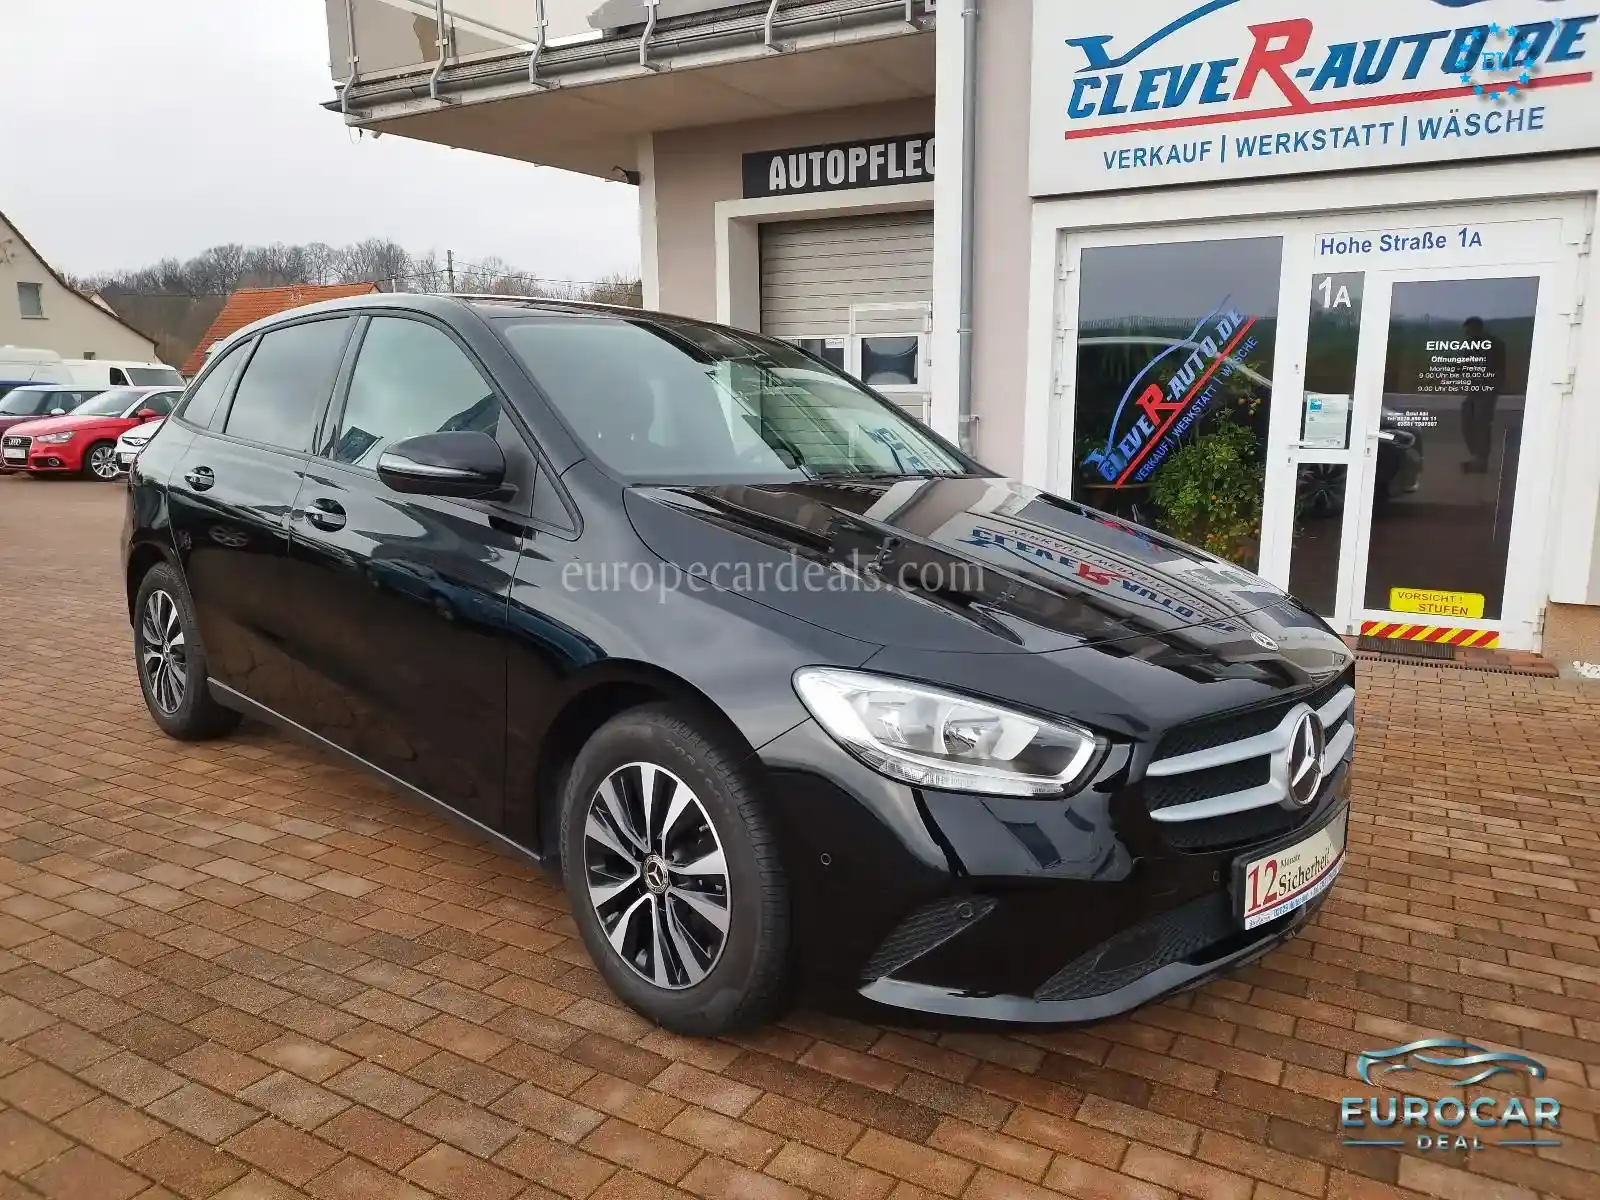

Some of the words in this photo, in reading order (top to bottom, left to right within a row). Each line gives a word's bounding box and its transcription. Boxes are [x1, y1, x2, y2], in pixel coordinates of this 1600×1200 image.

[1103, 143, 1213, 171] VERKAUF
[1236, 120, 1394, 158] WERKSTATT
[1417, 106, 1546, 142] WÄSCHE
[1320, 236, 1372, 256] Hohe
[1379, 231, 1447, 252] Straße
[1457, 227, 1483, 248] 1A
[1318, 276, 1352, 309] 1A
[1426, 340, 1492, 351] EINGANG
[1135, 440, 1171, 483] VERKAUF
[1172, 384, 1218, 439] WERKSTATT
[1397, 591, 1457, 602] VORSICHT
[1418, 603, 1469, 616] STUFEN
[1247, 859, 1278, 913] 12
